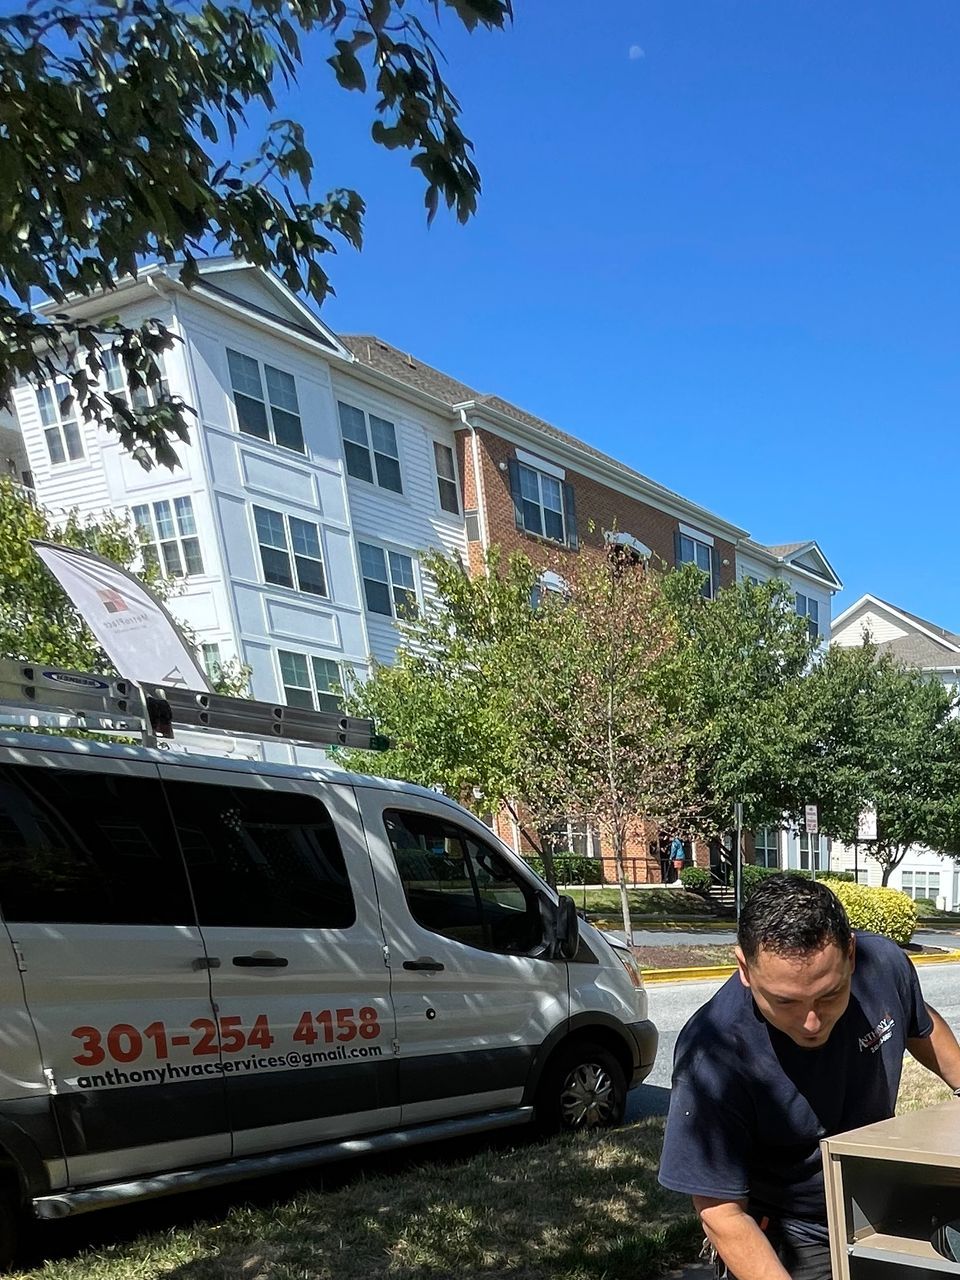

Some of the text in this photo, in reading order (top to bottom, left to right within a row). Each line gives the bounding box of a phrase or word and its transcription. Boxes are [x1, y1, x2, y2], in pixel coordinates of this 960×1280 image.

[70, 1006, 381, 1067] 301-254 4158
[77, 1043, 383, 1089] anthonyhvacservices@gmail.com
